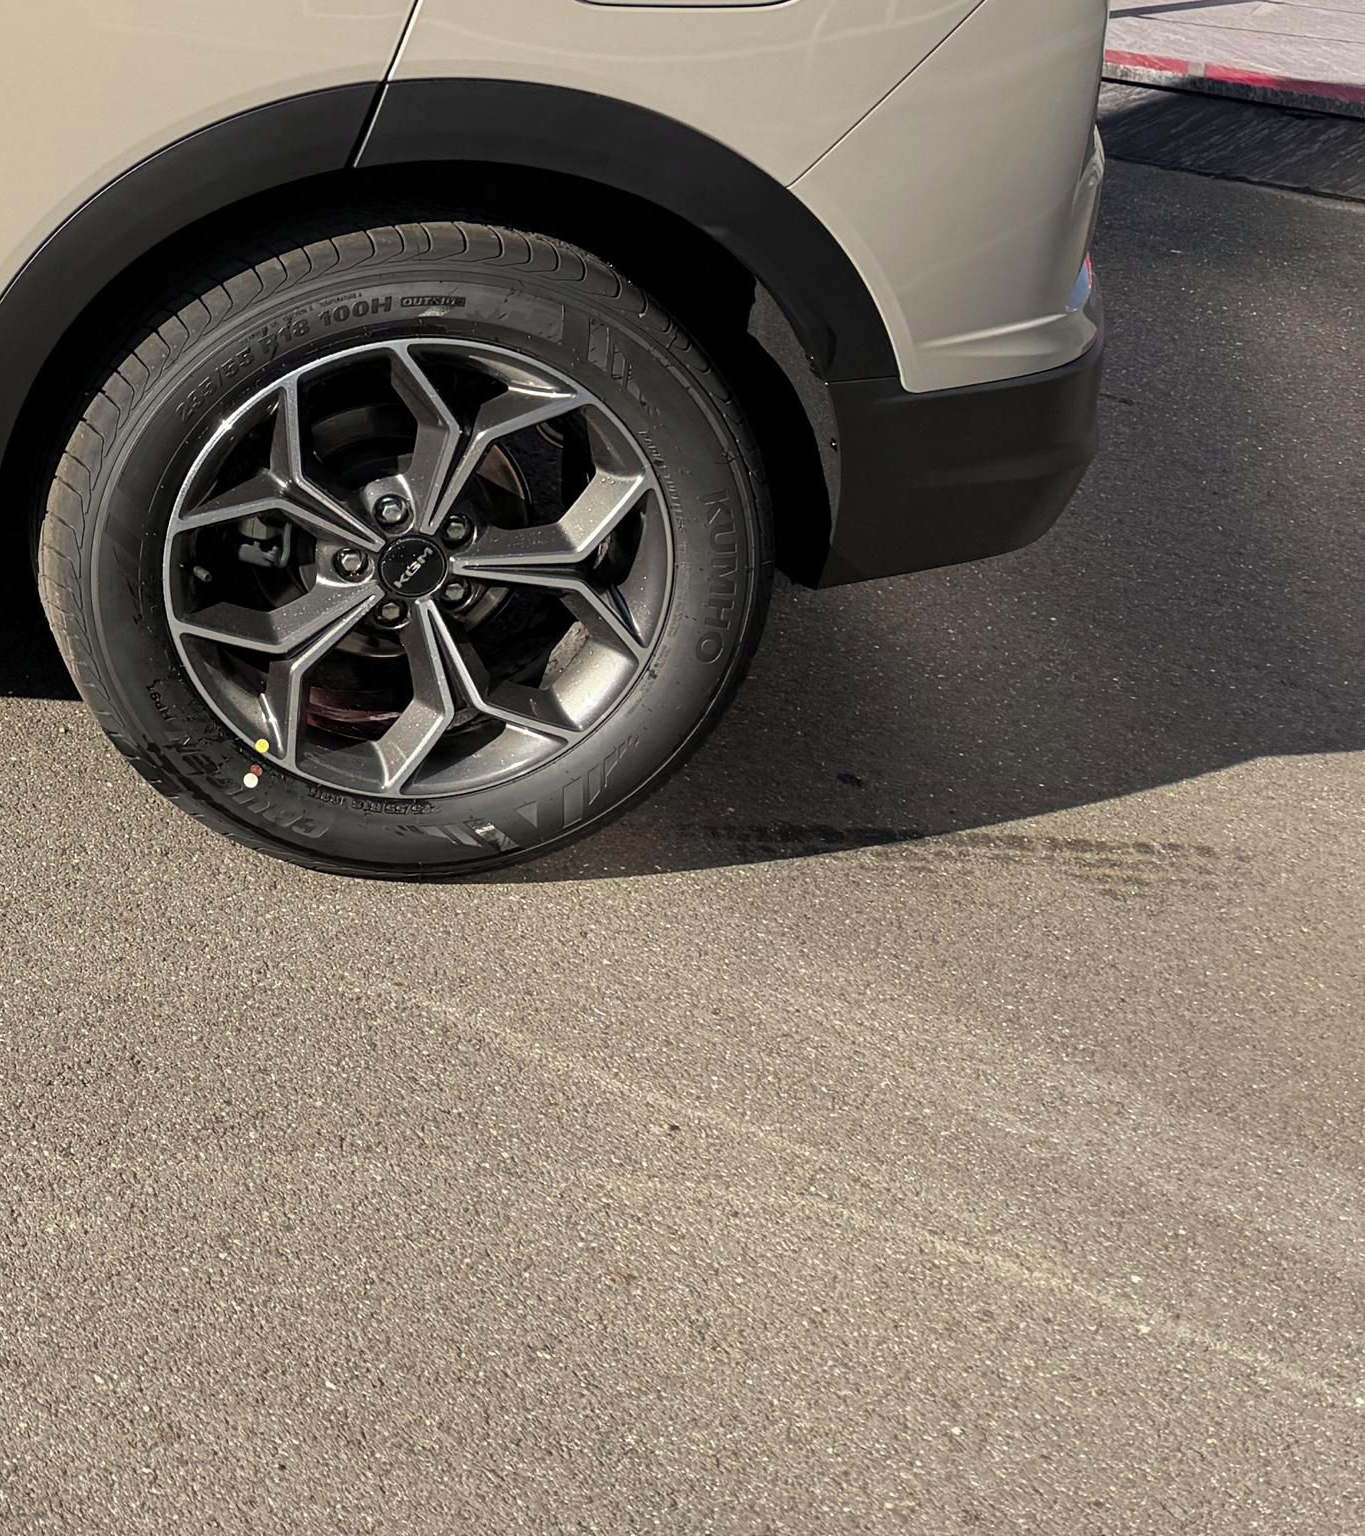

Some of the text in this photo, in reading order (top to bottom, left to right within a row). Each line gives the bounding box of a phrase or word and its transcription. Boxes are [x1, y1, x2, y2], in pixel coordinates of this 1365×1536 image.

[318, 296, 393, 327] 100H
[393, 547, 433, 589] KGM
[695, 489, 738, 664] KUMHO
